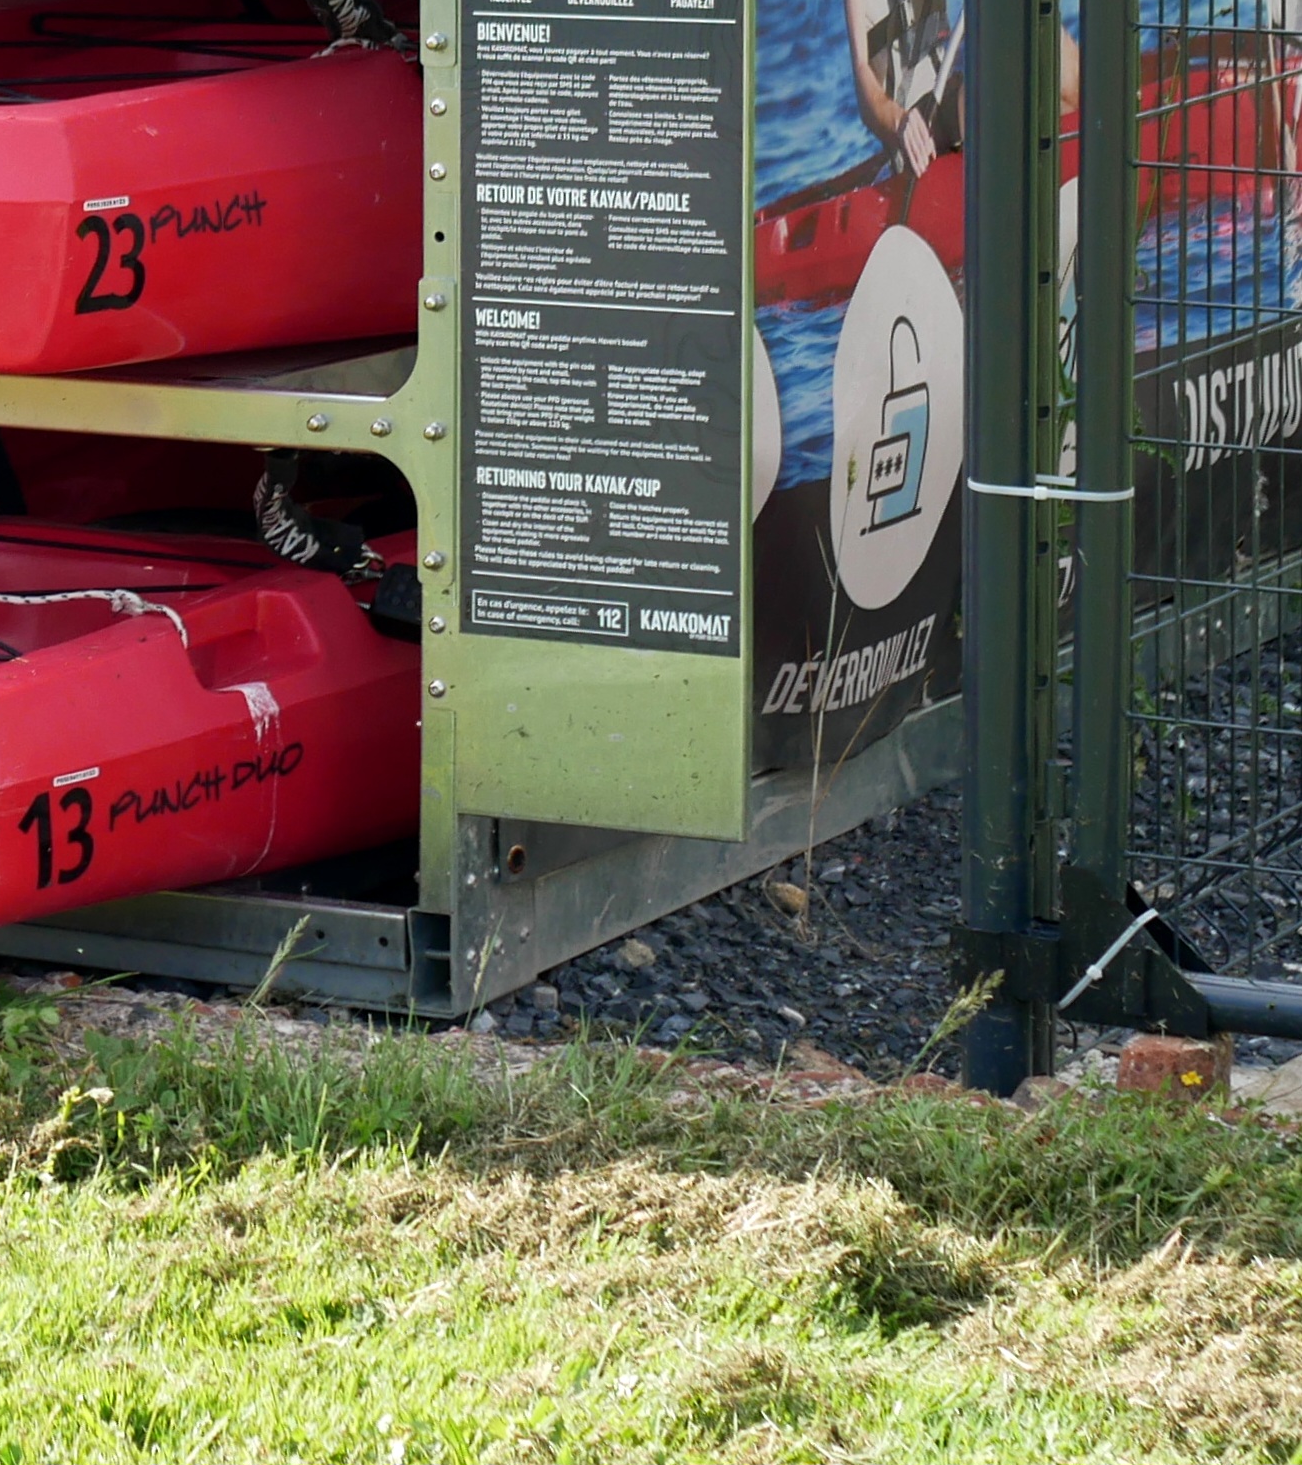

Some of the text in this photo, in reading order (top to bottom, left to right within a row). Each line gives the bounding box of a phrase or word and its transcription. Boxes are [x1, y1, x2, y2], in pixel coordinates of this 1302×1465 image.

[477, 22, 551, 43] BIENVENUE!
[476, 184, 690, 213] RETOUR DE VOTRE KAYAK/PADDLE
[149, 190, 268, 243] PUNCH
[74, 212, 146, 315] 23
[475, 308, 541, 330] WELCOME!
[476, 466, 661, 497] RETURNING YOUR KAYAK/SUP
[477, 597, 590, 616] En cas d'urgence, appelez le:
[477, 608, 580, 626] In case of emergency, call:
[597, 607, 621, 629] 112
[640, 608, 732, 637] KAYAKOMAT
[761, 613, 937, 716] DÉVERROUILLEZ
[109, 741, 304, 831] PUNCH DUO
[18, 786, 95, 890] 13
